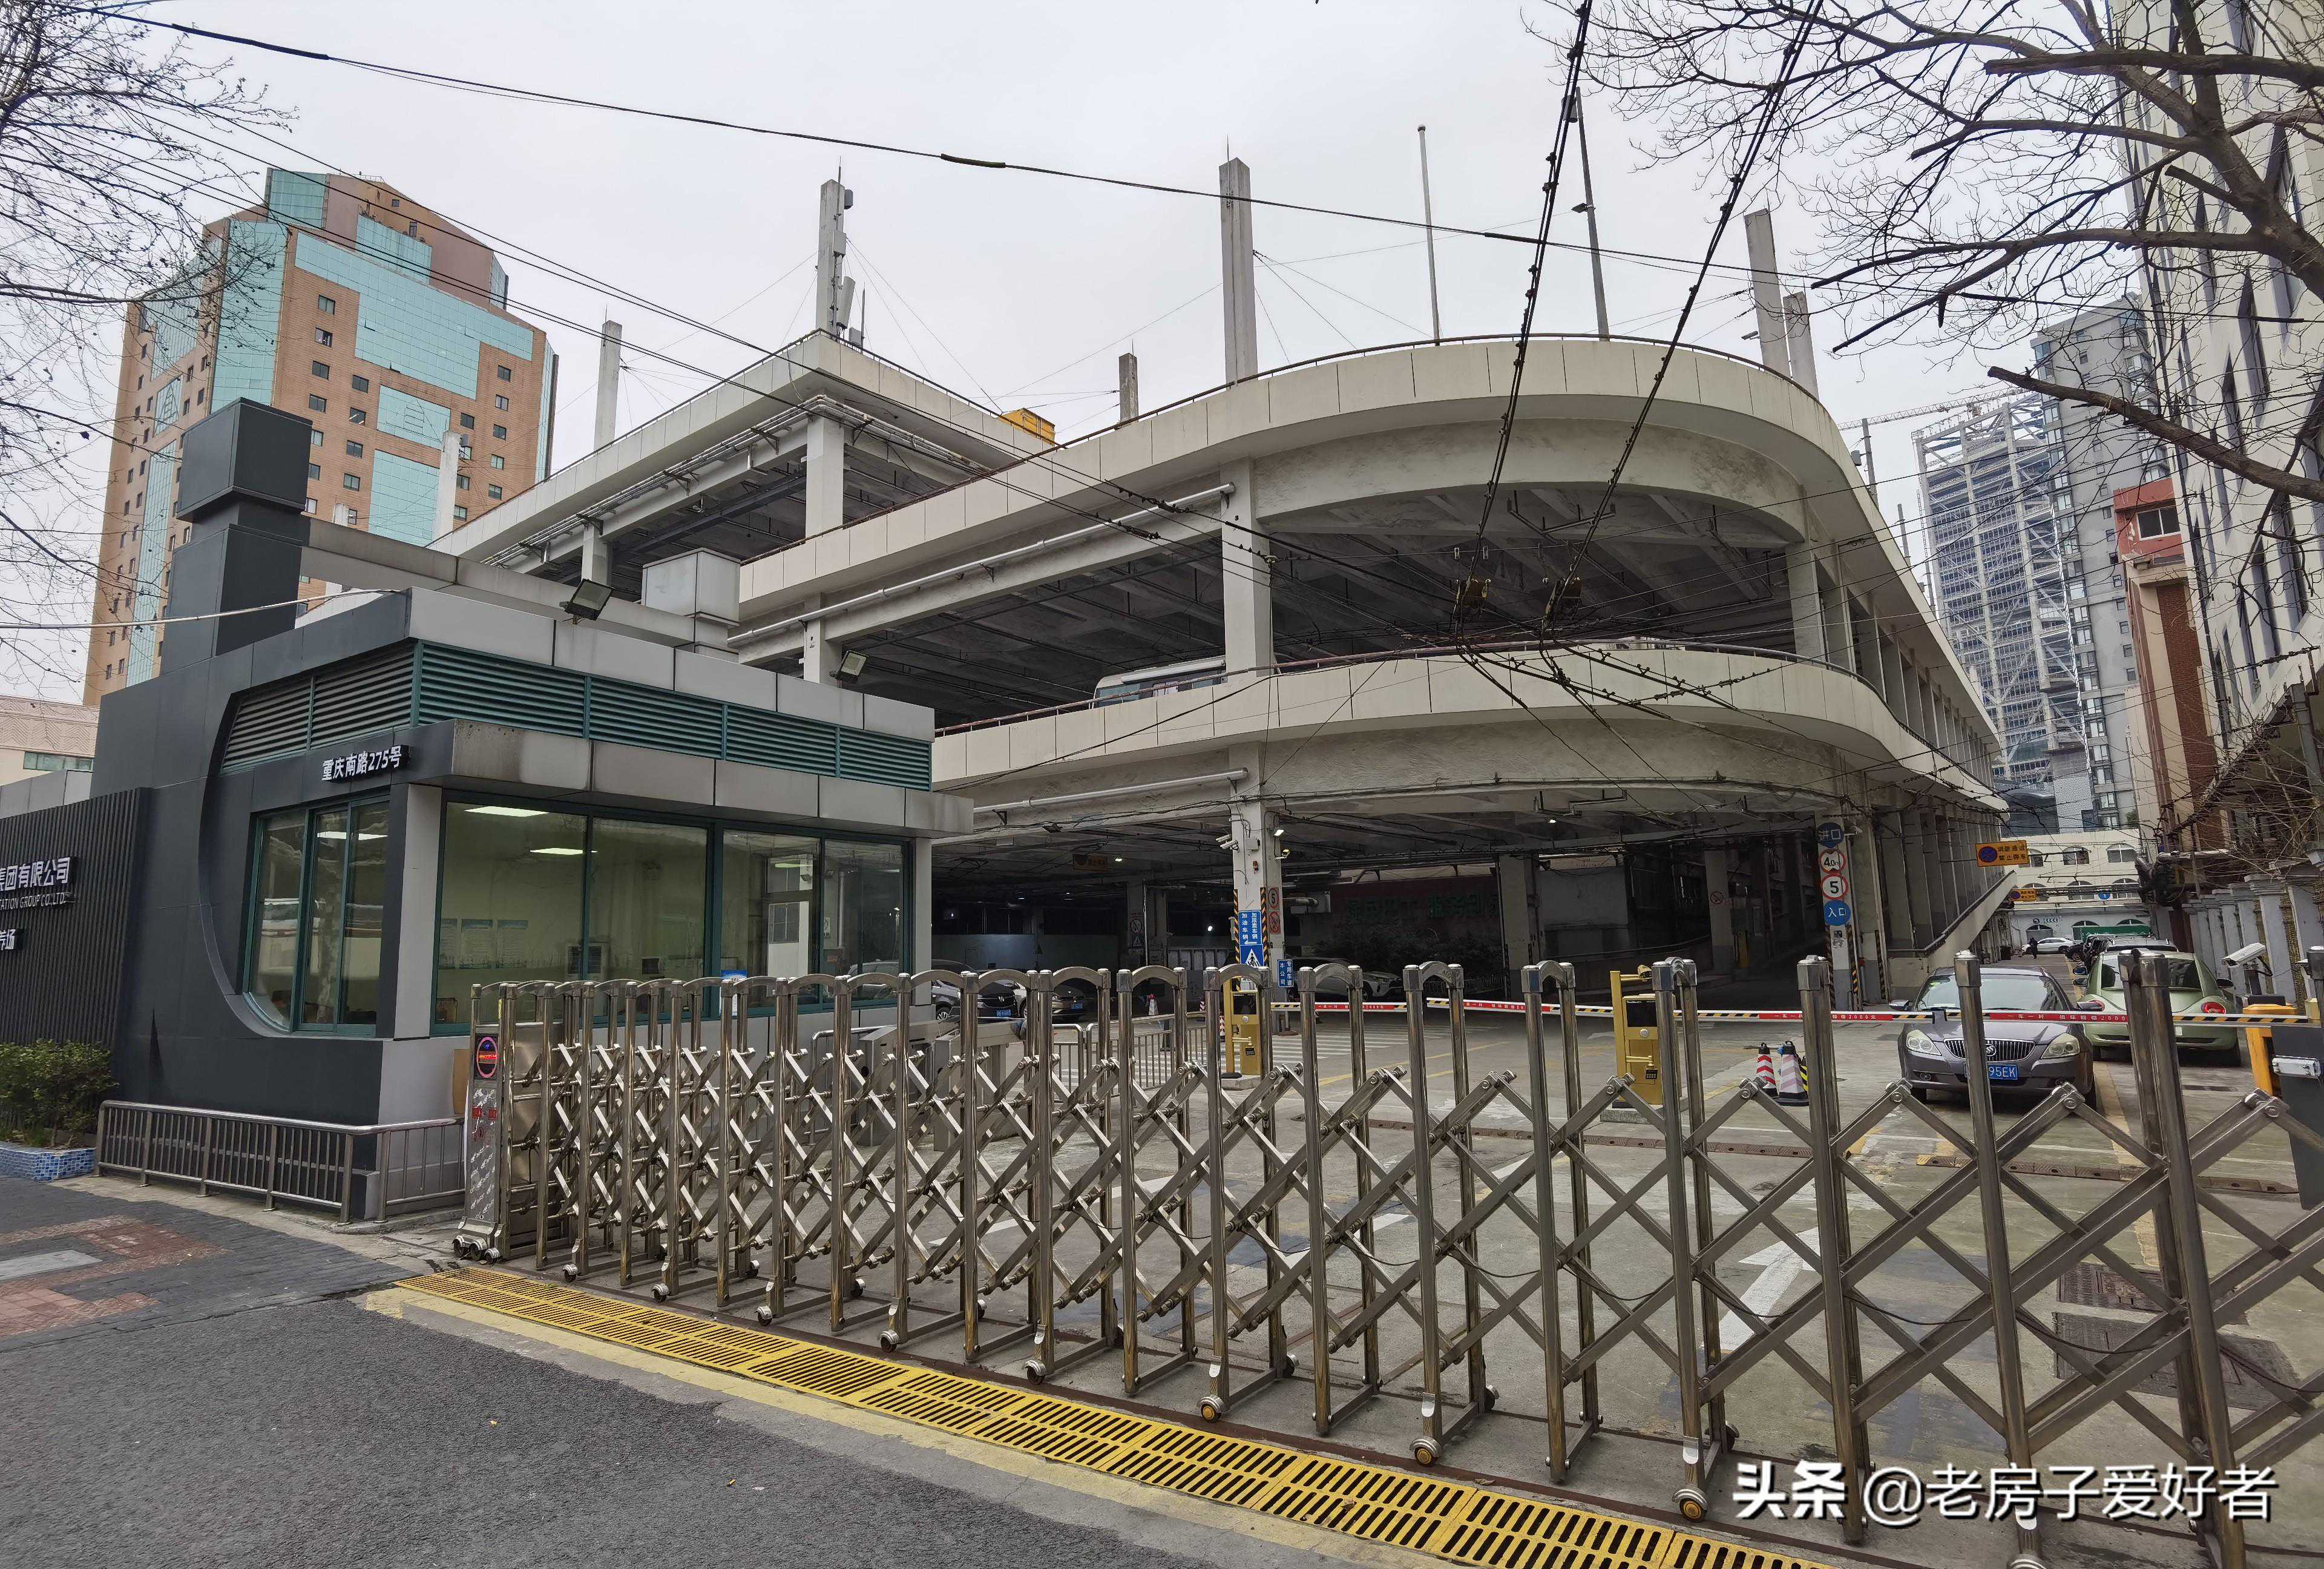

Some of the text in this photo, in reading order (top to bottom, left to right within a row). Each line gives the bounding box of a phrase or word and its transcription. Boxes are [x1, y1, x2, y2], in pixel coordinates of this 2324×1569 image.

[322, 746, 401, 780] 重庆南路275号
[1830, 881, 1839, 893] 5
[1272, 893, 1276, 904] 5
[1828, 908, 1846, 917] 入口
[1989, 1066, 2016, 1078] 95EK
